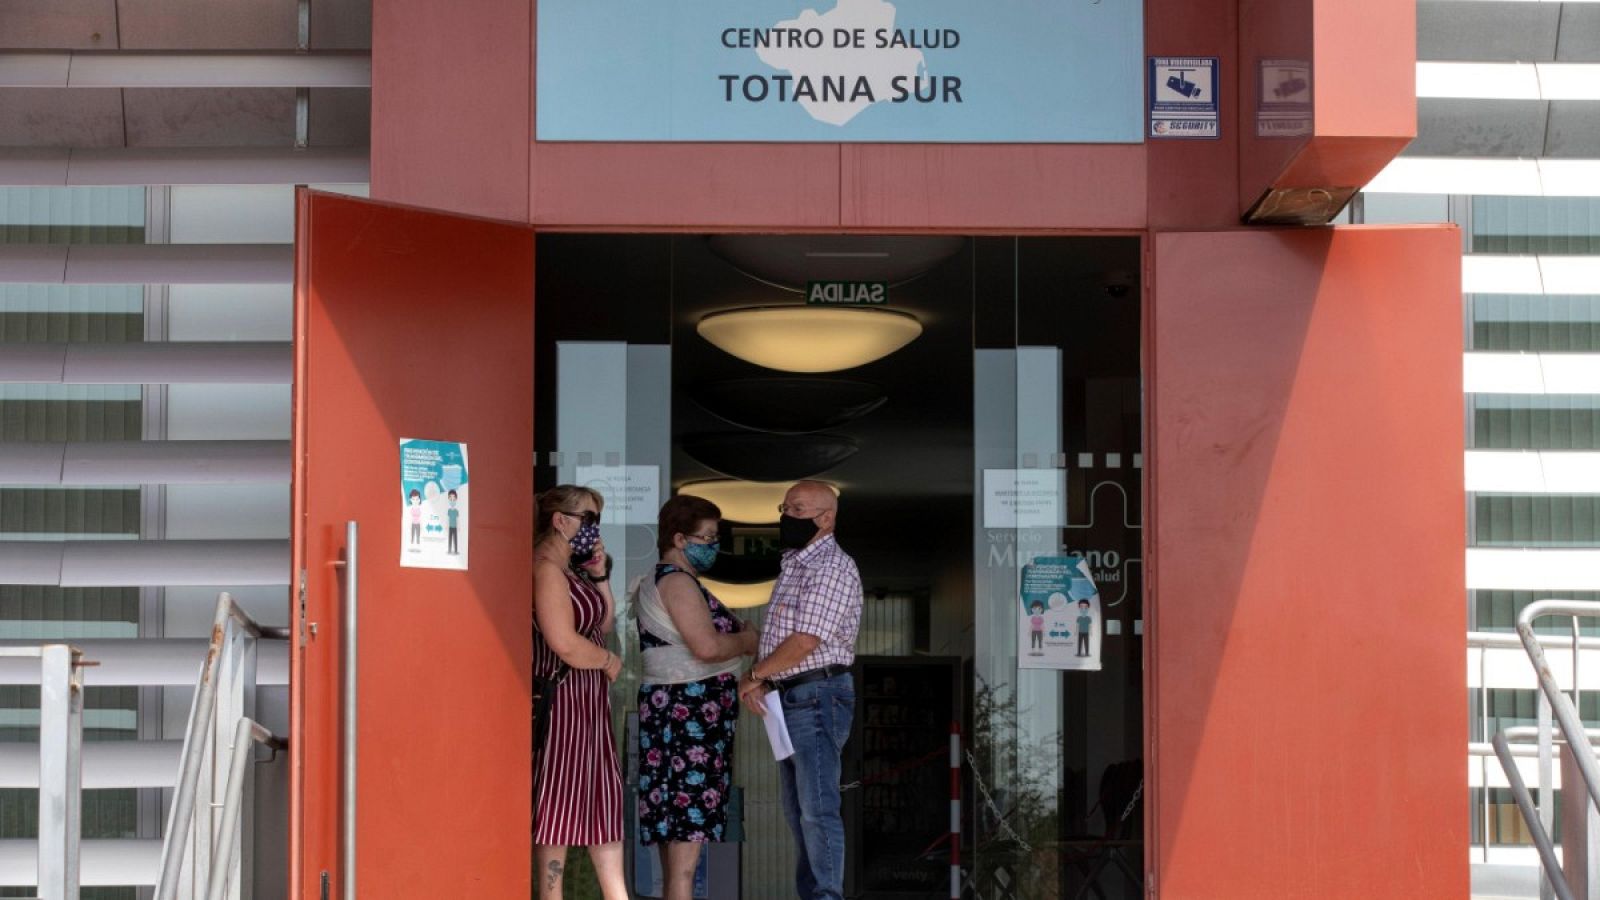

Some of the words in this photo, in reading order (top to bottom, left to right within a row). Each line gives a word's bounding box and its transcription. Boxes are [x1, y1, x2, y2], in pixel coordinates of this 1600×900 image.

[721, 28, 824, 49] CENTRO
[833, 28, 865, 49] DE
[875, 28, 961, 49] SALUD
[718, 75, 876, 103] TOTANA
[891, 75, 963, 103] SUR
[1169, 121, 1216, 130] SECURITY
[986, 530, 1042, 543] Servicio
[1092, 569, 1120, 582] alud
